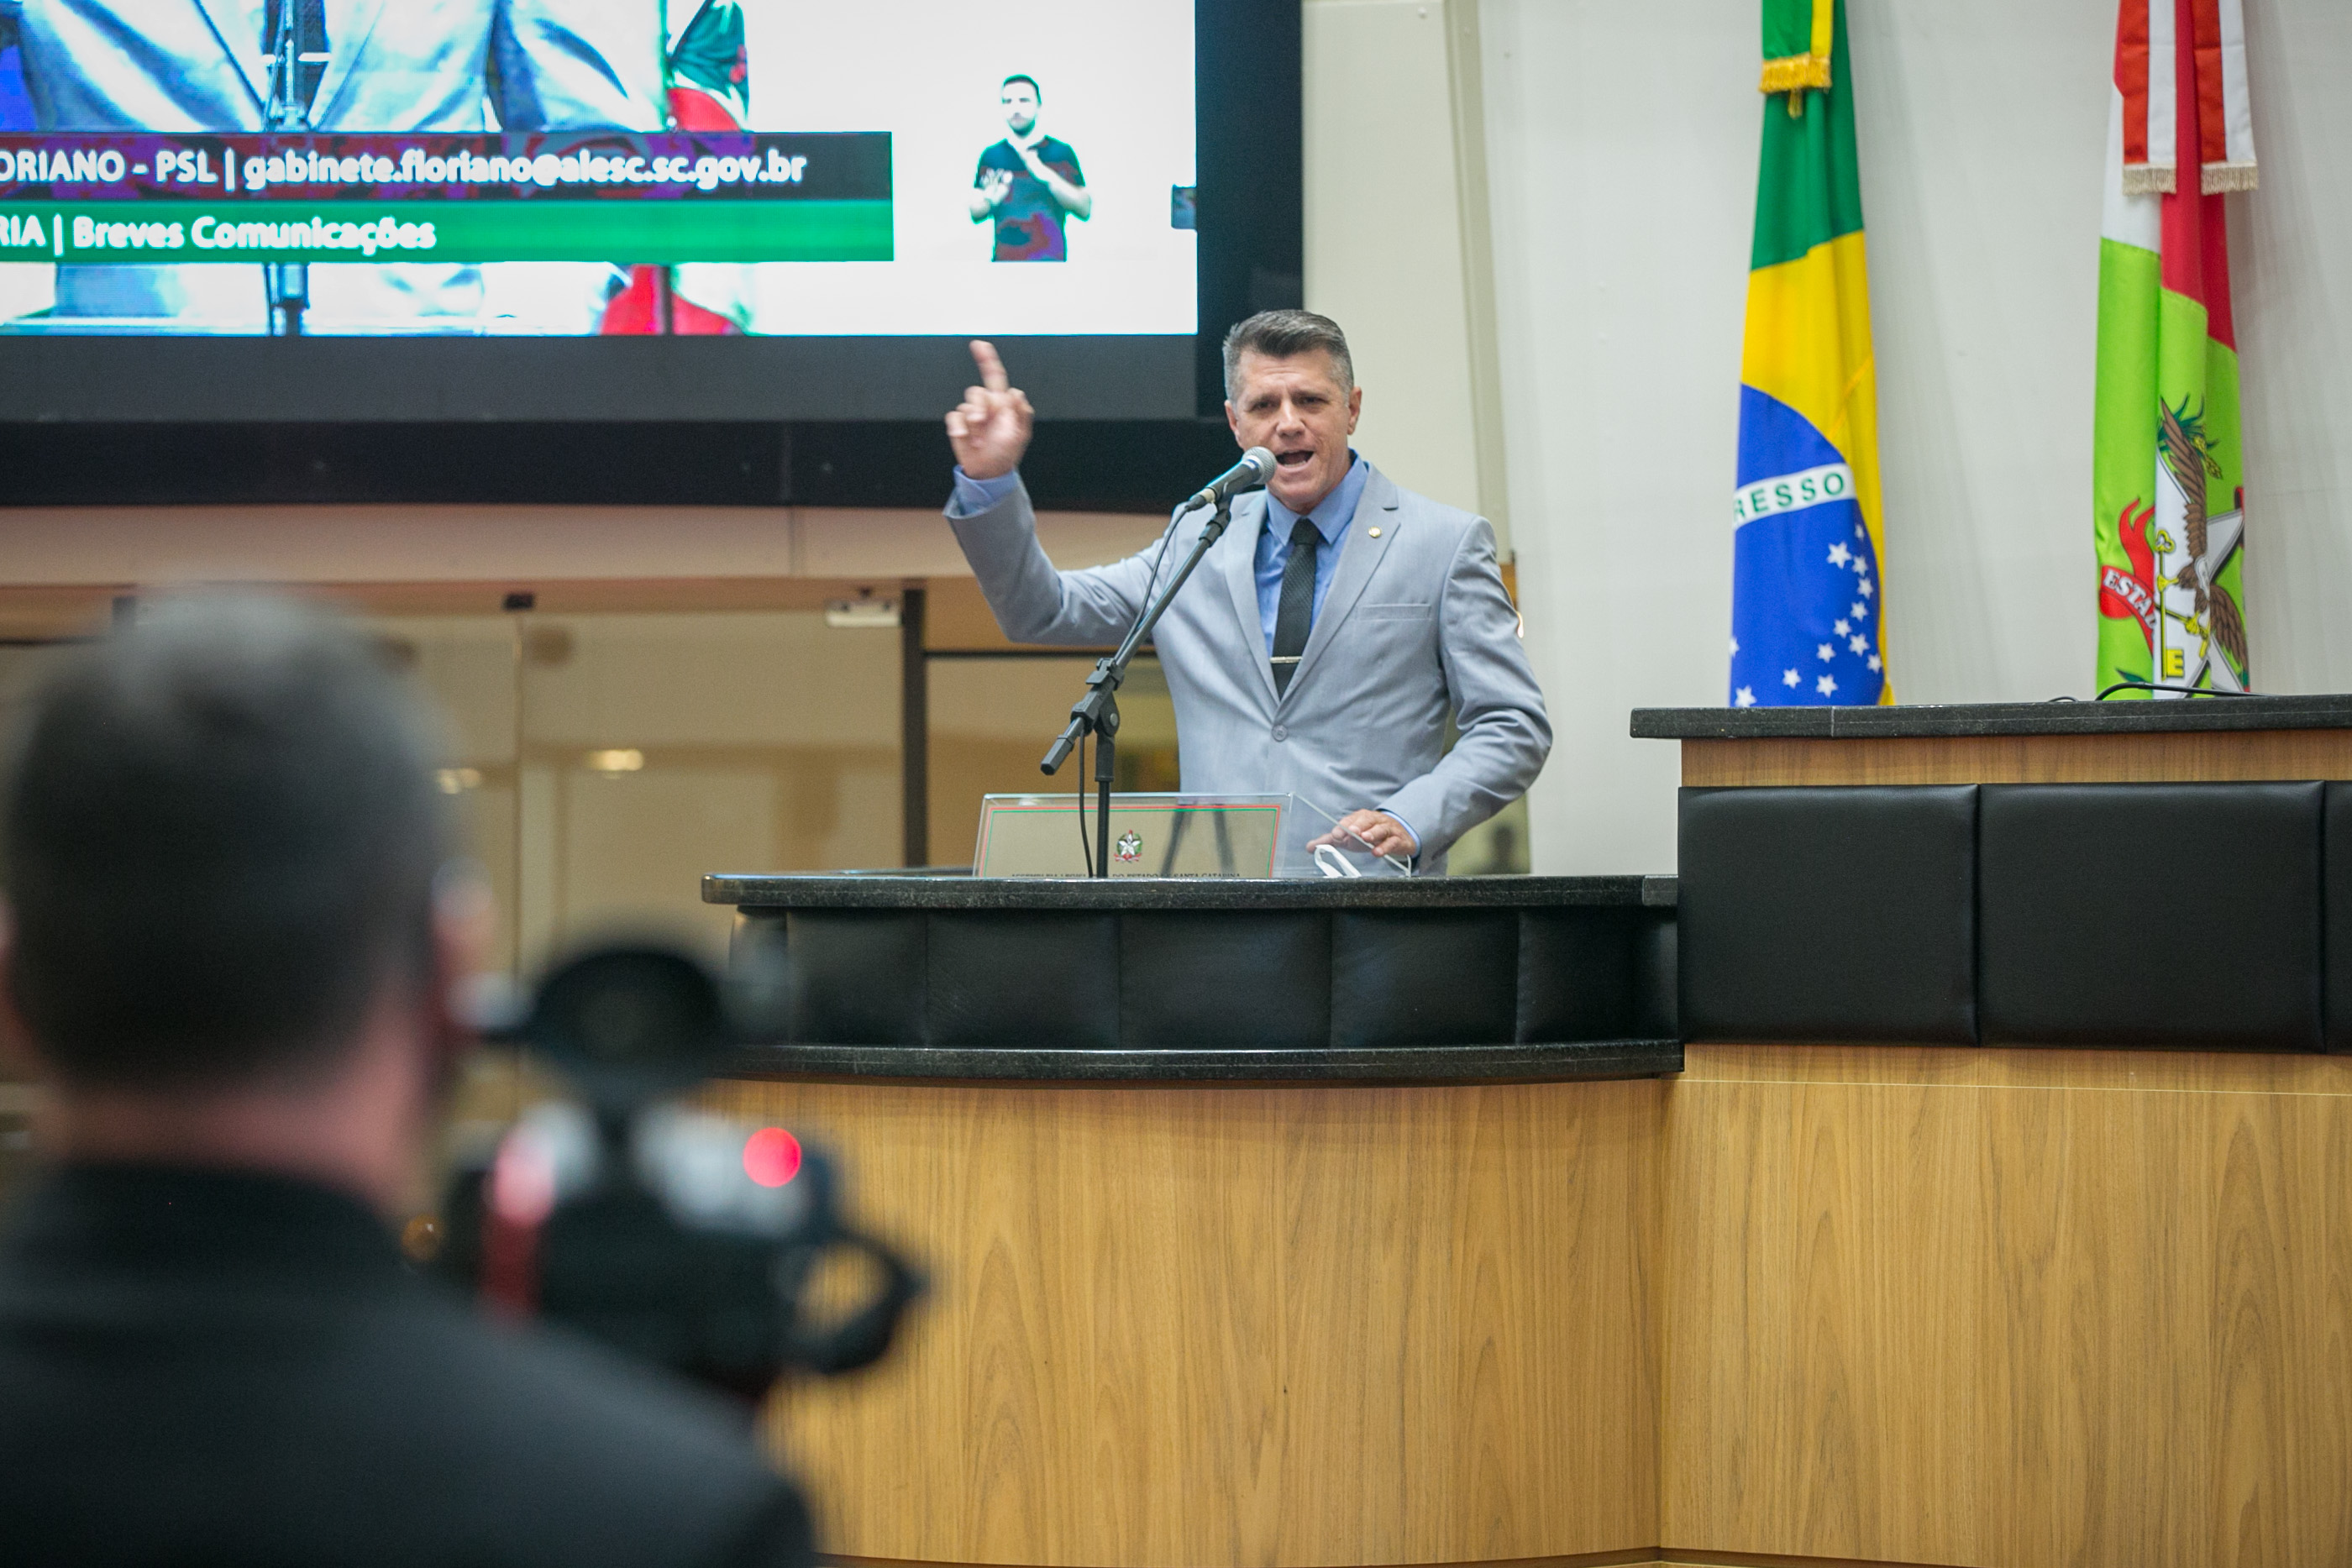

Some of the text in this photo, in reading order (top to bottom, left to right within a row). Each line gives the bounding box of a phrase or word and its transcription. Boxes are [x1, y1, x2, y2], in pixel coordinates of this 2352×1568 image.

[0, 149, 125, 182] ORIANO
[156, 149, 217, 182] PSL
[244, 147, 807, 190] gabinete.floriano@alesc.sc.gov.br
[73, 215, 185, 249] Breves
[191, 215, 438, 255] Comunicações
